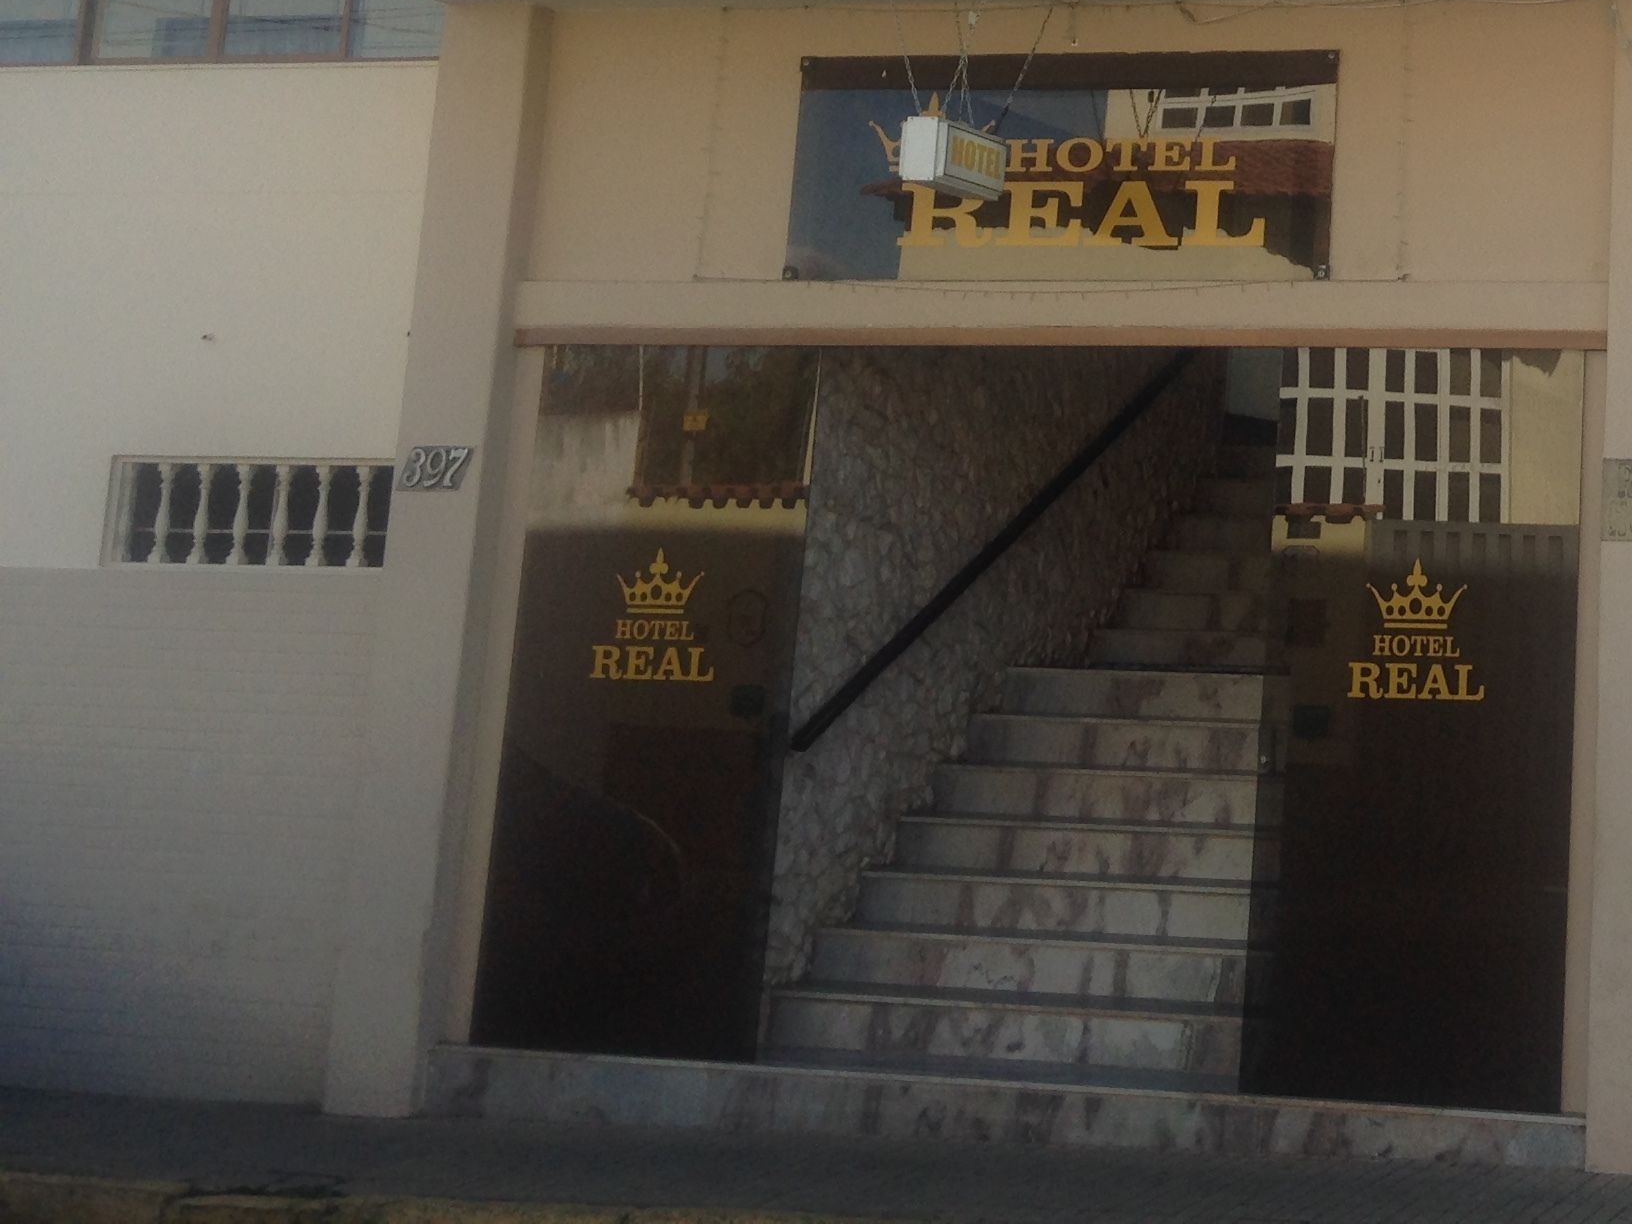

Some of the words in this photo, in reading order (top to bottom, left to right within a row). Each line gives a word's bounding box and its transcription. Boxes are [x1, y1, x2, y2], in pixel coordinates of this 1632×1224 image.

[951, 136, 1001, 180] HOTEL
[1006, 137, 1237, 173] HOTEL
[897, 179, 1265, 248] REAL
[401, 448, 469, 487] 397
[615, 619, 695, 641] HOTEL
[1372, 634, 1460, 658] HOTEL
[589, 644, 715, 682] REAL
[1347, 661, 1486, 701] REAL
